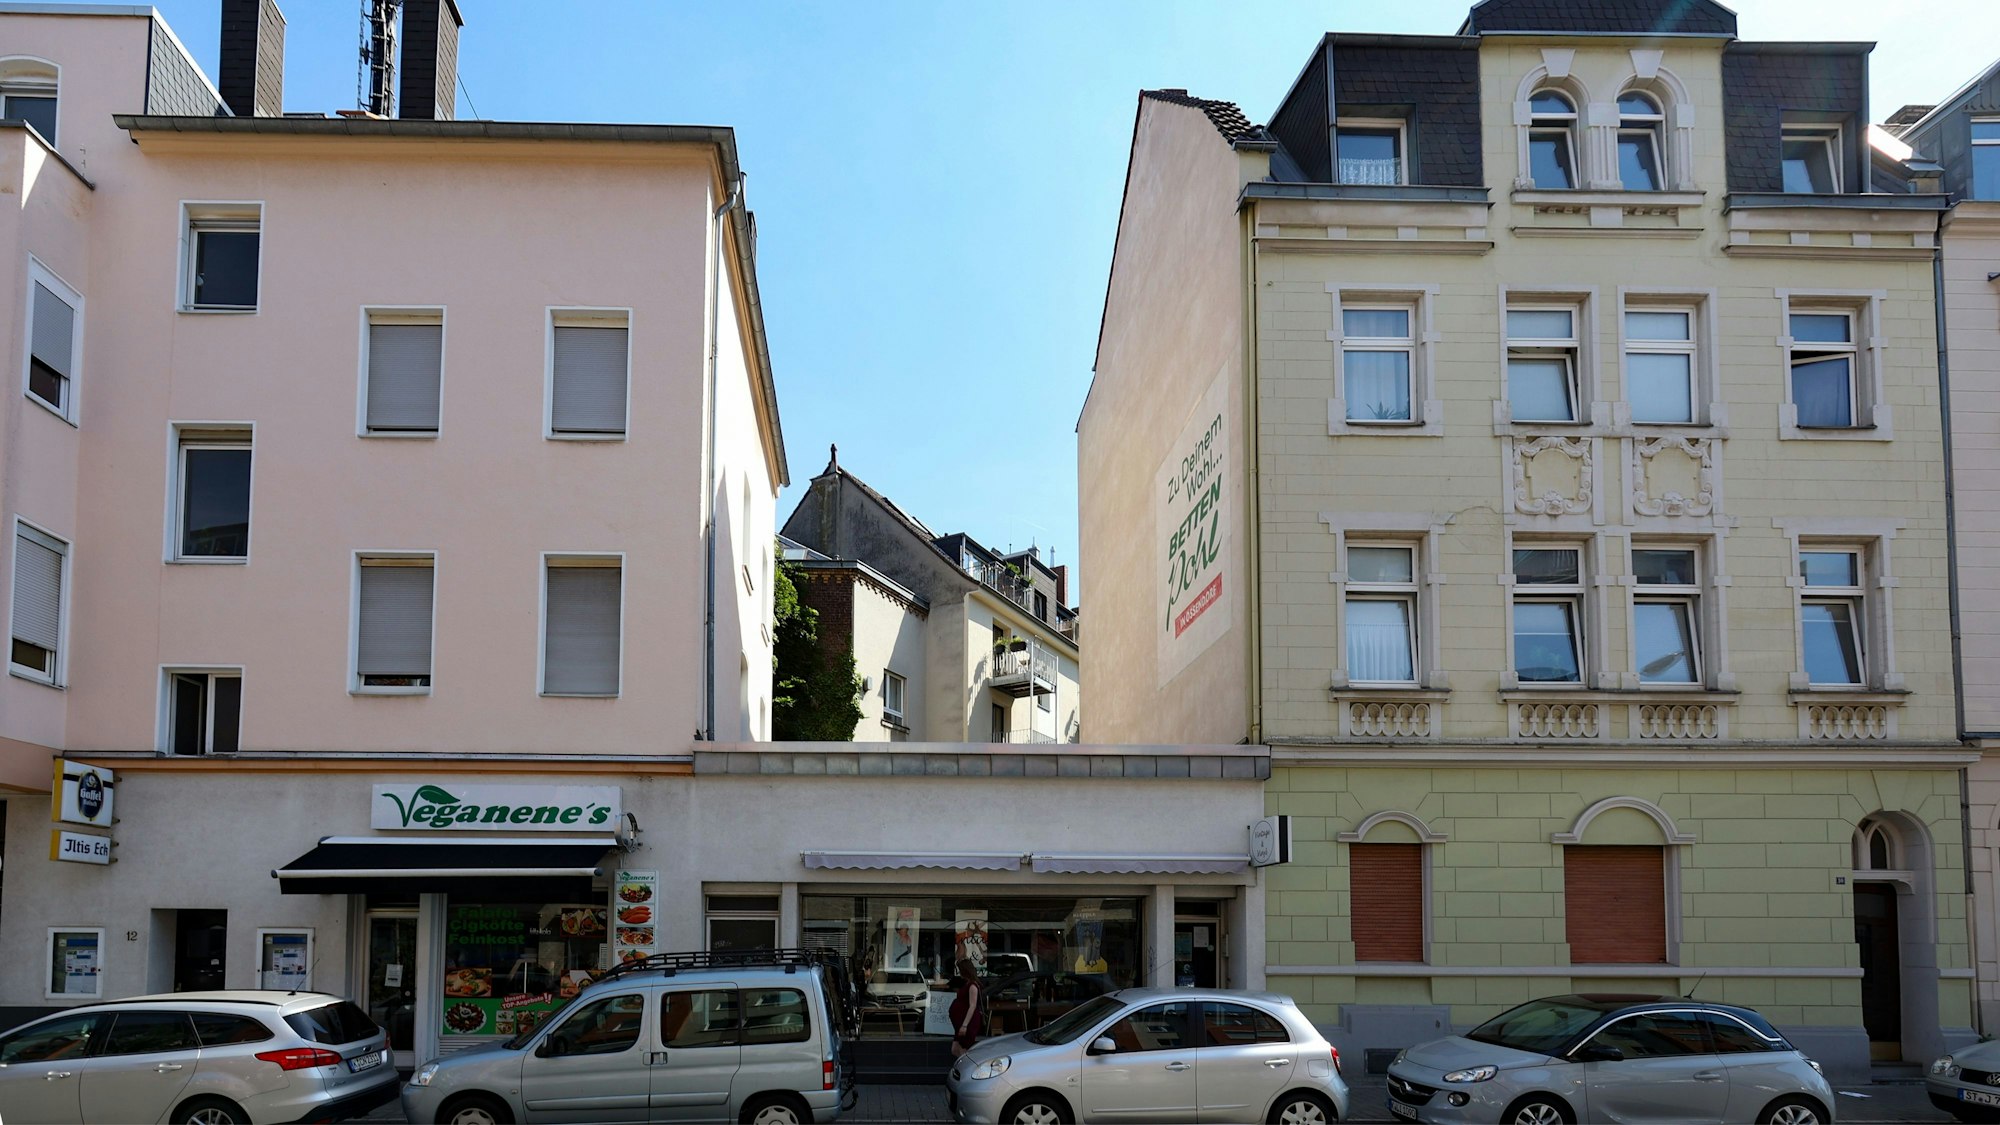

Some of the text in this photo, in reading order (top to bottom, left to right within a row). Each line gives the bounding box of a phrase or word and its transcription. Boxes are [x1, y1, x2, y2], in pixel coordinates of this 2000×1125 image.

[1168, 413, 1222, 504] Zu Deinem
[1169, 472, 1222, 561] BETTEN
[1166, 509, 1223, 632] Pohl
[80, 787, 102, 801] Gaffel
[381, 785, 612, 828] Veganene's
[94, 842, 109, 856] Eck
[458, 907, 518, 919] Falafel
[126, 931, 138, 942] 12
[449, 933, 526, 945] Feinkost
[504, 994, 526, 1003] Unsere
[1966, 1091, 1977, 1101] ST
[1984, 1095, 1991, 1103] J
